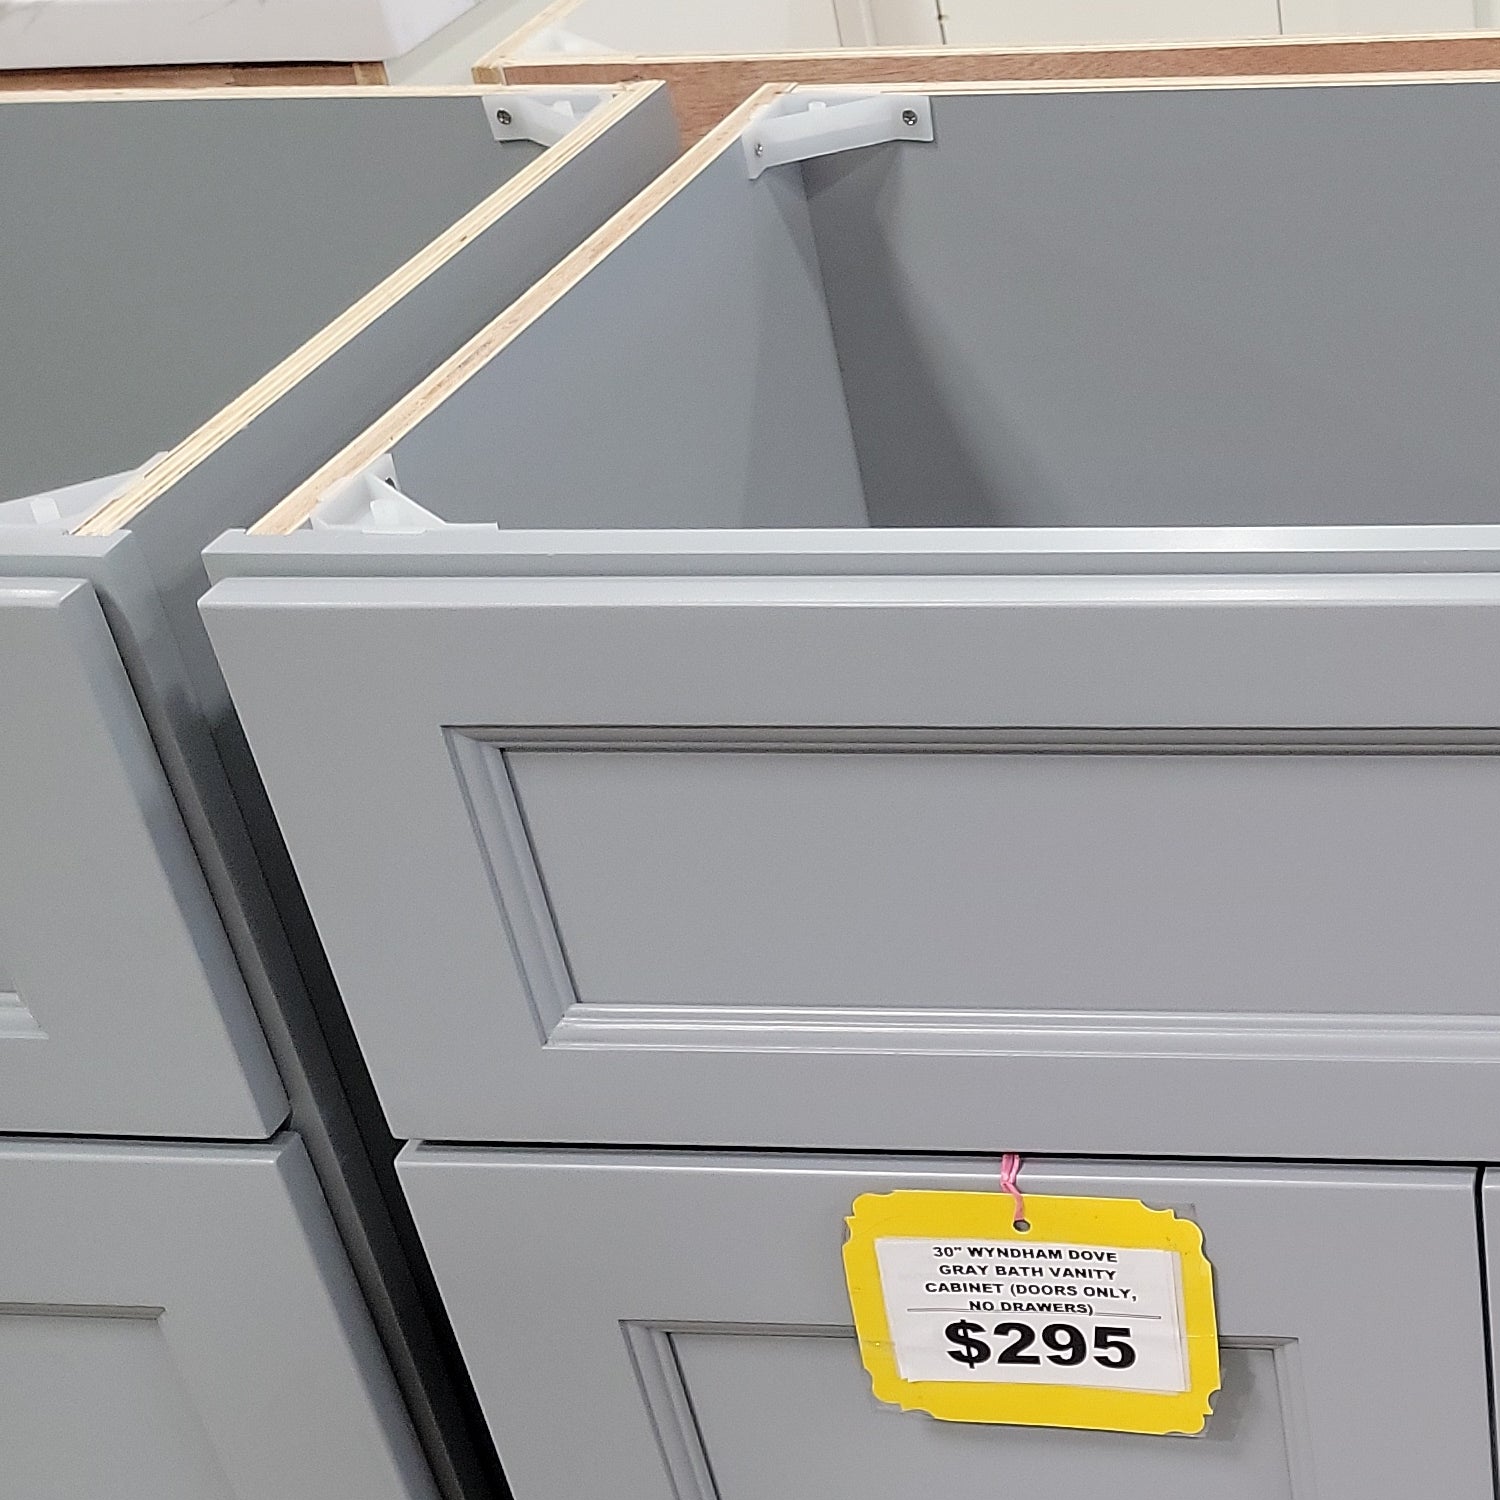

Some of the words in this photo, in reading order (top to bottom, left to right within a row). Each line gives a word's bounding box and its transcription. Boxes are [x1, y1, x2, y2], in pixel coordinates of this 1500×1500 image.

[933, 1246, 962, 1258] 30"
[968, 1247, 1063, 1260] WYNDHAM
[1069, 1249, 1118, 1263] DOVE
[939, 1265, 989, 1276] GRAY
[995, 1266, 1044, 1278] BATH
[1049, 1267, 1117, 1281] VANITY
[925, 1282, 1004, 1294] CABINET
[1010, 1283, 1078, 1297] (DOORS
[1083, 1286, 1138, 1302] ONLY,
[969, 1301, 995, 1312] NO
[1001, 1302, 1094, 1316] DRAWERS)
[945, 1319, 1137, 1369] $295
